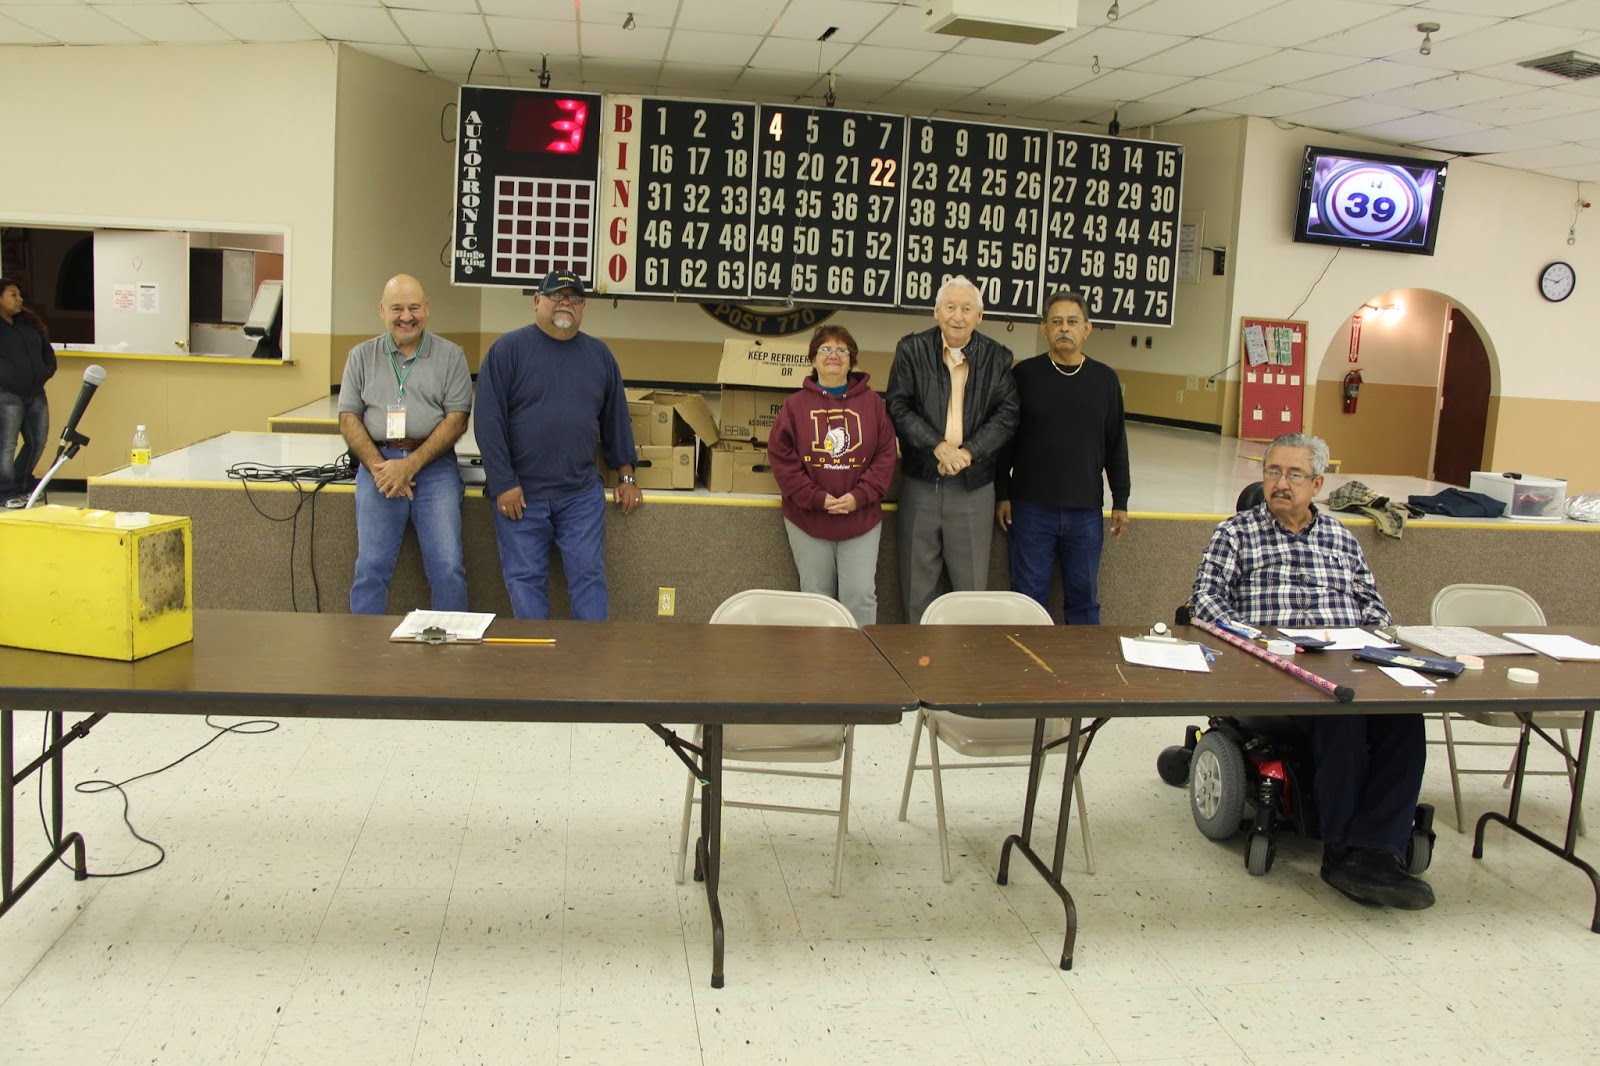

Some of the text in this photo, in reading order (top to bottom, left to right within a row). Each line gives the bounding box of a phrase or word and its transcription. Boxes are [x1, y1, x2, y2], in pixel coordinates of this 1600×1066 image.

[546, 100, 589, 154] 3
[658, 108, 1175, 177] 1 2 3 4 5 6 7 8 9 10 11 12 13 14 15
[461, 110, 482, 250] AUTOTRONIC
[608, 104, 633, 283] BINGO
[650, 145, 1174, 213] 16 17 18 19 20 21 22 23 24 25 26 27 28 29 30
[648, 182, 1172, 247] 31 32 33 34 35 36 37 38 39 40 41 42 43 44 45
[1344, 192, 1396, 223] 39
[456, 250, 485, 260] Bingo
[461, 257, 485, 268] King
[644, 220, 1170, 282] 46 47 48 49 50 51 52 53 54 55 56 57 58 59 60
[645, 257, 668, 285] 61
[681, 259, 707, 287] 62
[718, 261, 744, 289] 63
[754, 261, 780, 289] 64
[791, 264, 817, 293] 65
[828, 266, 853, 295] 66
[864, 268, 890, 296] 67
[906, 271, 932, 300] 68
[976, 277, 1001, 305] 70
[1012, 279, 1033, 306] 71
[1080, 286, 1103, 313] 73
[1113, 288, 1134, 315] 74
[1144, 290, 1167, 317] 75
[714, 304, 816, 333] POST 770
[748, 350, 769, 361] KEEP
[771, 353, 811, 364] REFRIGER
[781, 367, 793, 376] OR
[804, 456, 866, 464] DONN
